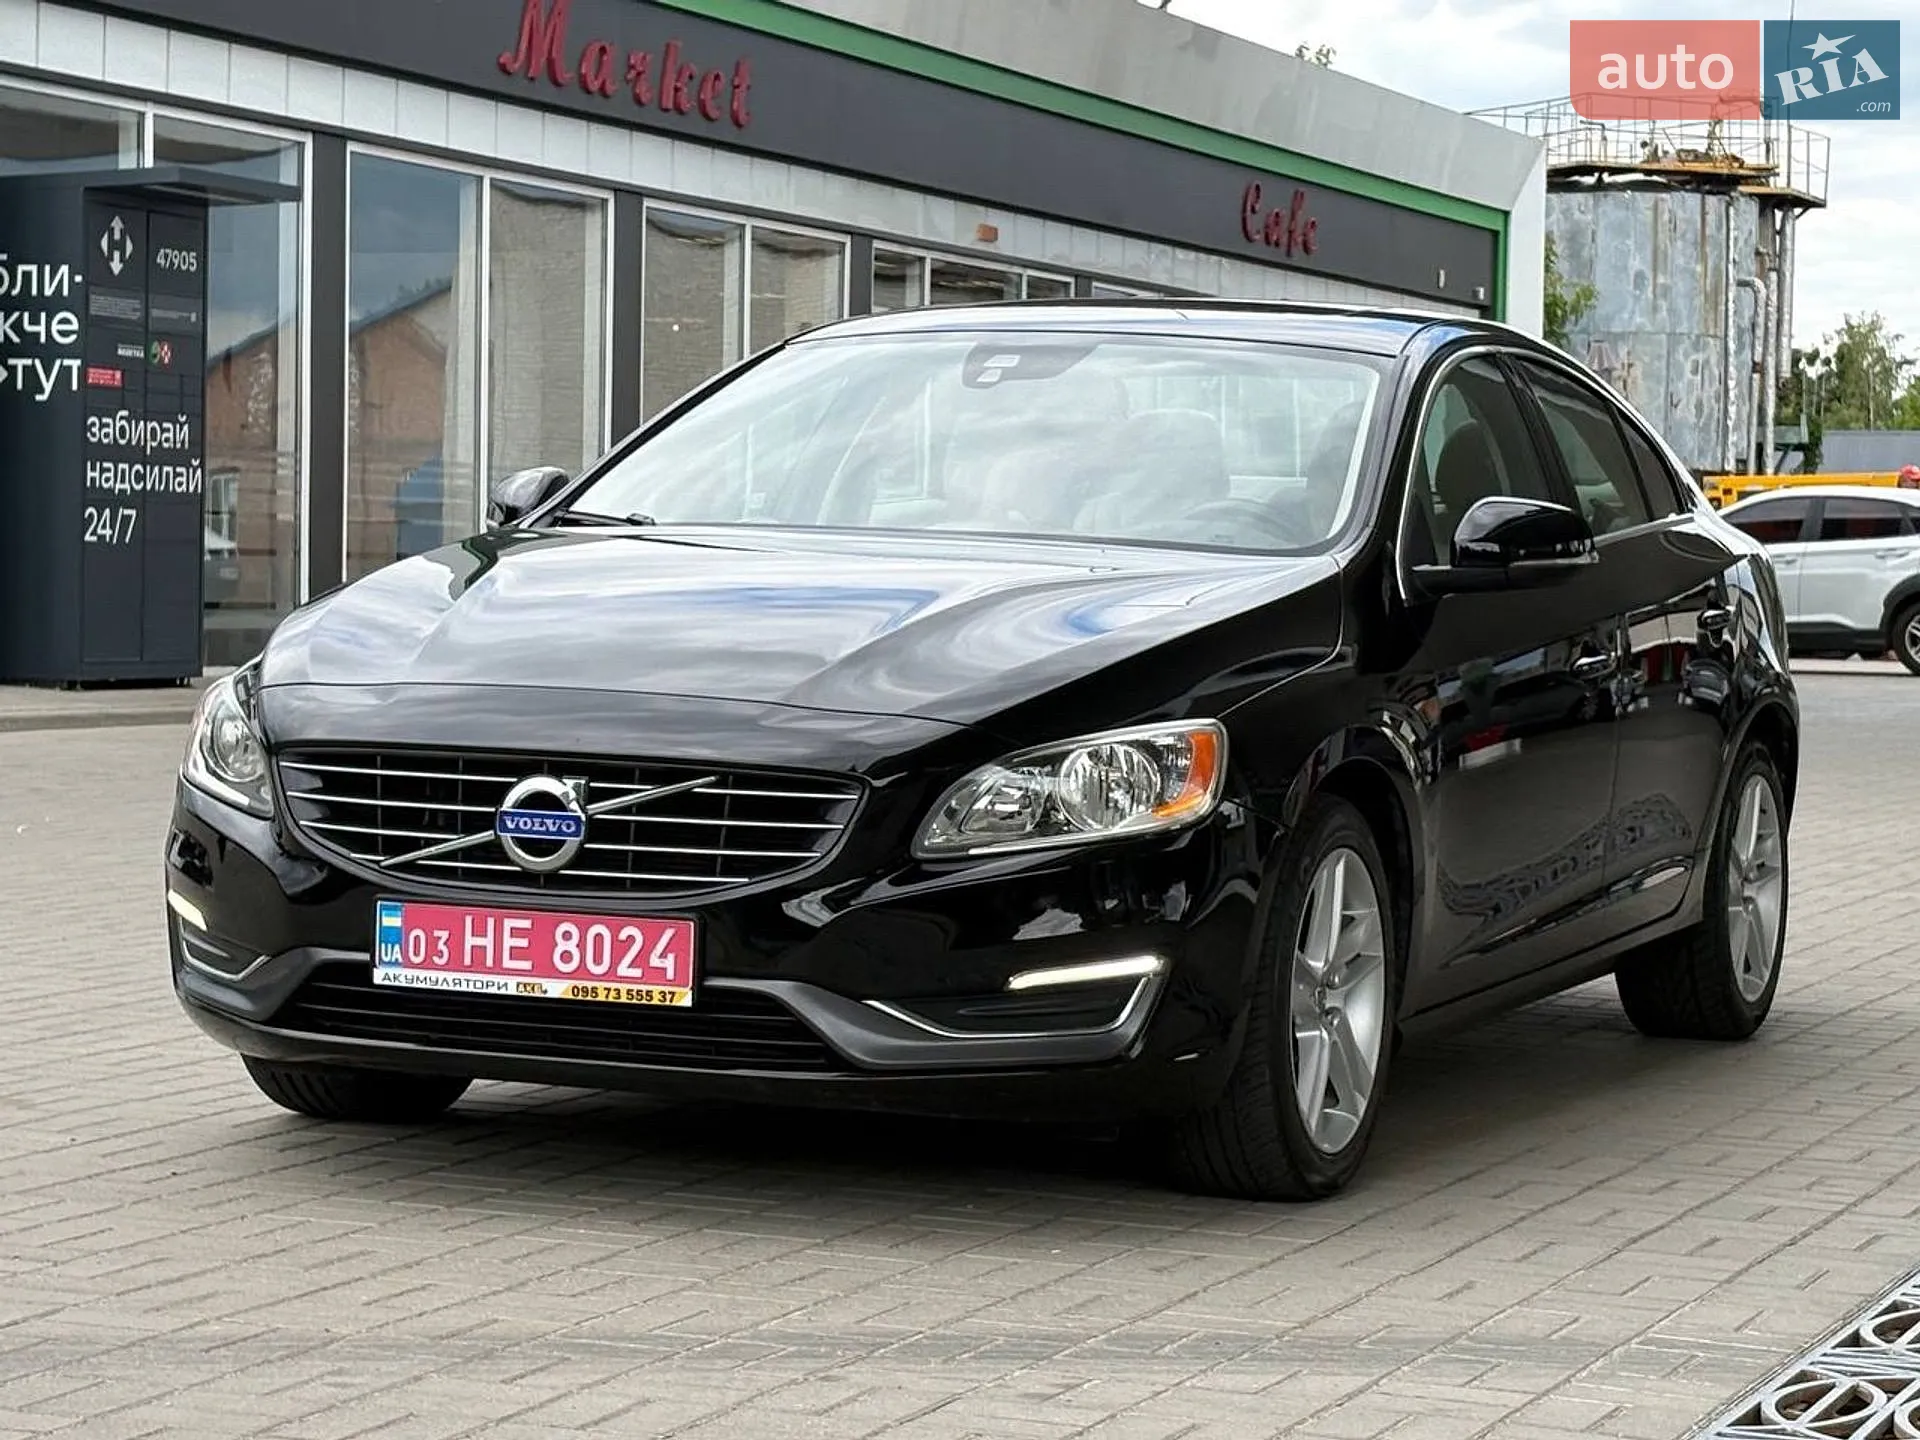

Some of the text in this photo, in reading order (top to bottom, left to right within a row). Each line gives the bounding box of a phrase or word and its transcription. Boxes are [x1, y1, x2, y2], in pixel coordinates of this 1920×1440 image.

[497, 0, 752, 129] Market
[1241, 180, 1319, 257] Cafe
[156, 247, 198, 272] 47905
[86, 409, 190, 455] забирай
[85, 458, 203, 493] надсилай
[84, 507, 137, 545] 24/7
[503, 815, 577, 833] VOLVO
[381, 944, 403, 963] UA
[408, 914, 677, 981] 03 HE 8024
[381, 972, 509, 992] АКУМУЛЯТОРИ
[571, 985, 677, 1003] 095 73 555 37
